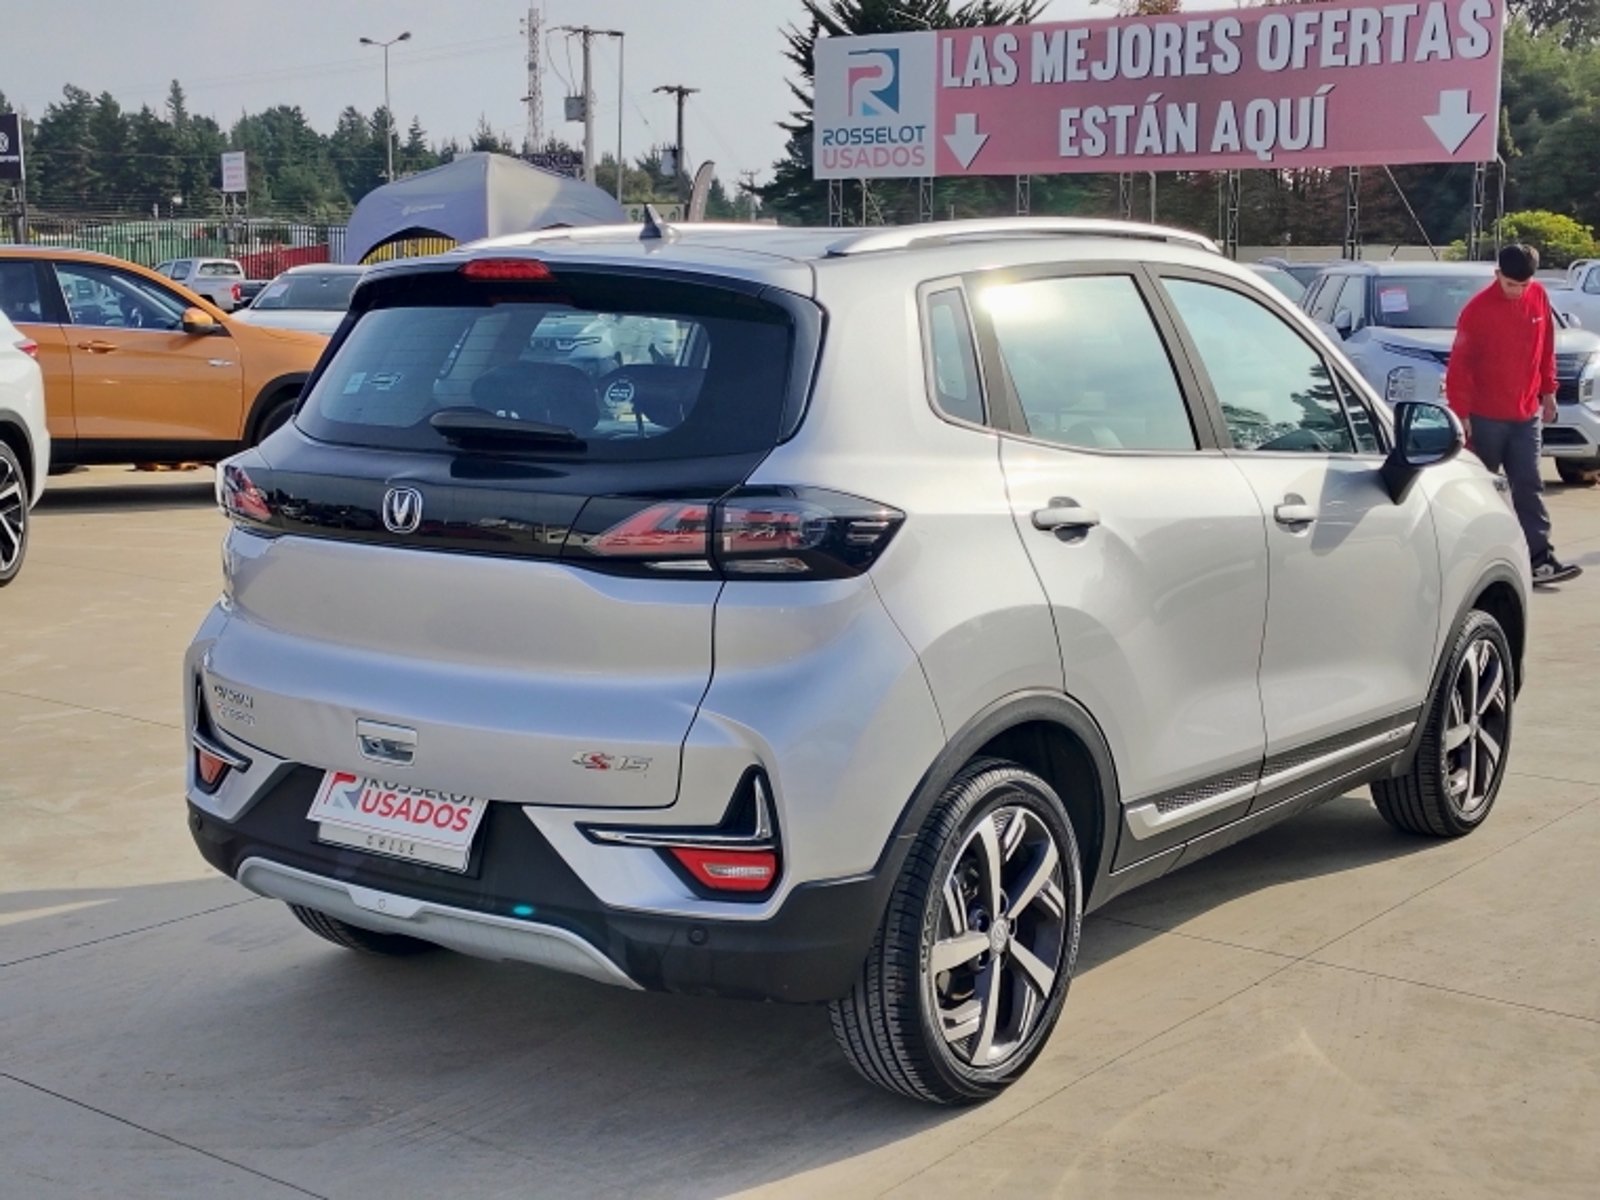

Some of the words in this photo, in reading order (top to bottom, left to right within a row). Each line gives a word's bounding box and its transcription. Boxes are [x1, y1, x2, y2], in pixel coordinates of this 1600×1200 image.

[942, 32, 1018, 88] LAS
[1031, 17, 1242, 84] MEJORES
[1256, 0, 1495, 73] OFERTAS
[822, 125, 926, 147] ROSSELOT
[1059, 92, 1198, 157] ESTÁN
[1210, 84, 1336, 162] AQUÍ
[822, 145, 926, 169] USADOS
[361, 788, 472, 832] USADOS
